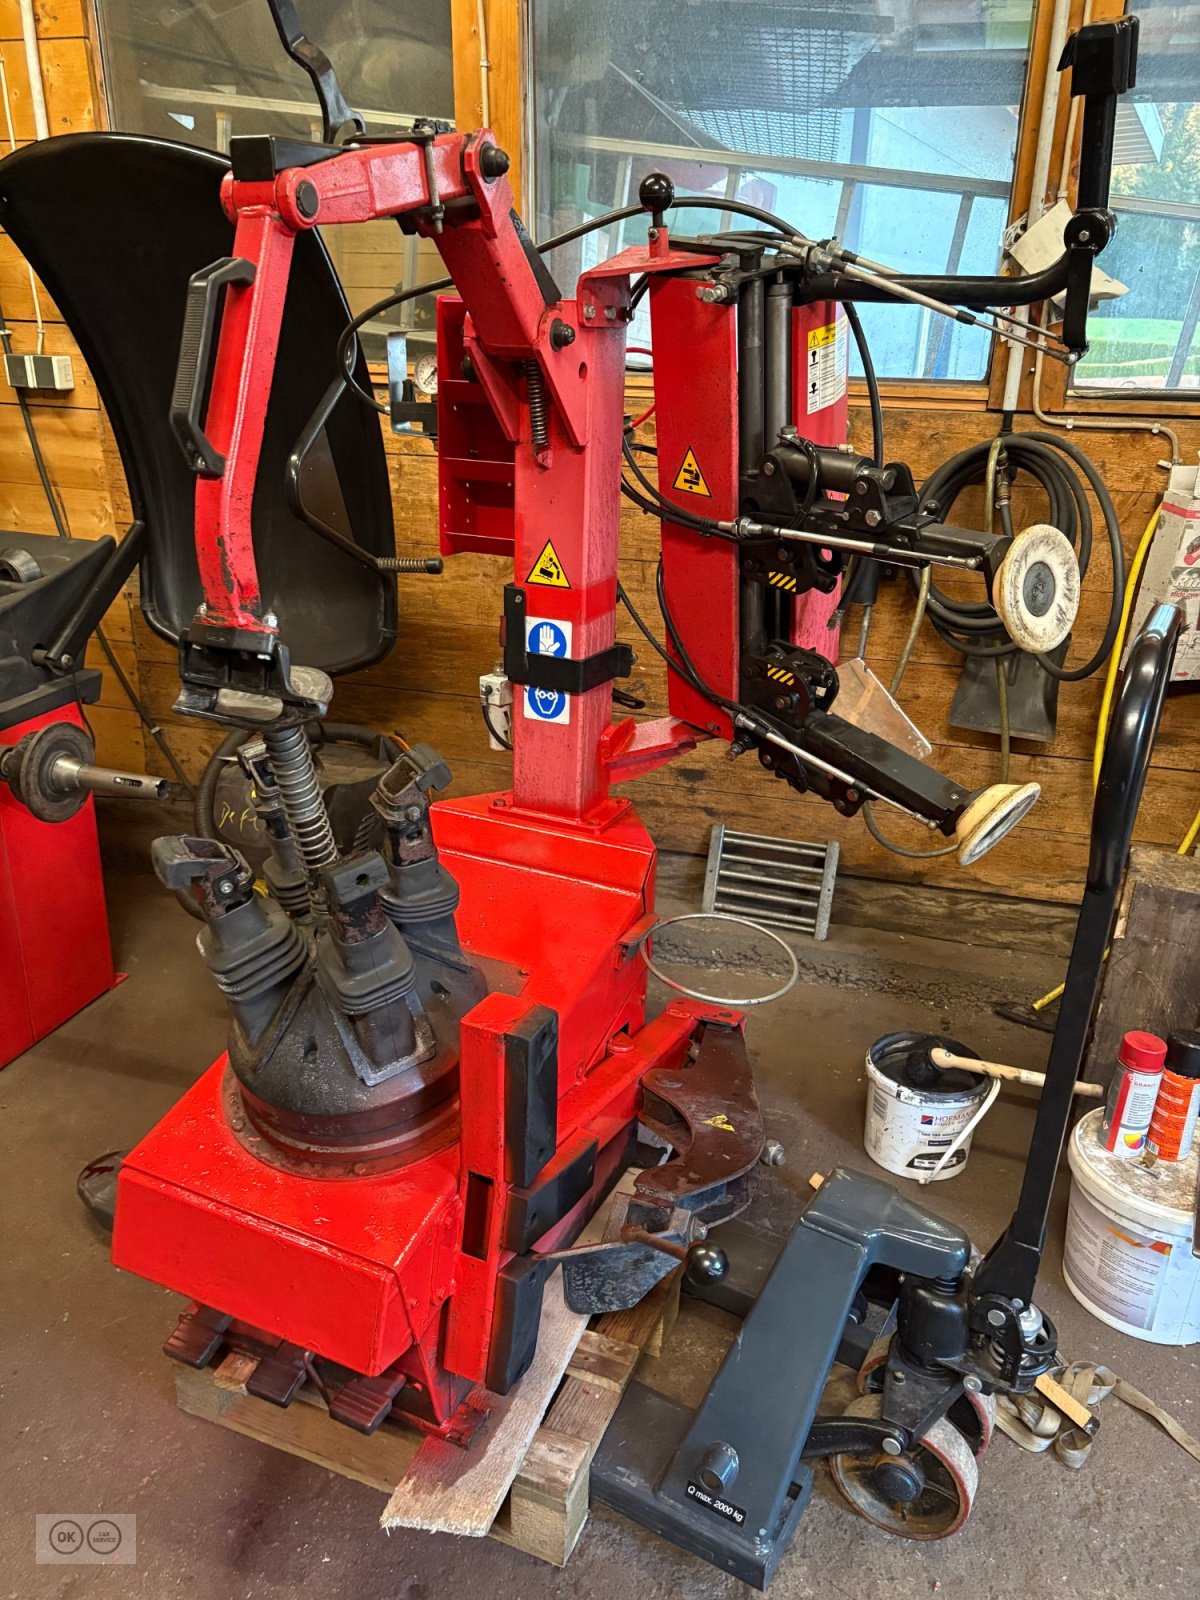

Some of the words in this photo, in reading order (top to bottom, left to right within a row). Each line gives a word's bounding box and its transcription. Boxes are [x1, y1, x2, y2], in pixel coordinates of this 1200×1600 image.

[687, 1485, 696, 1495] Q
[695, 1491, 712, 1504] max.
[713, 1500, 733, 1515] 2000
[732, 1510, 744, 1522] kg
